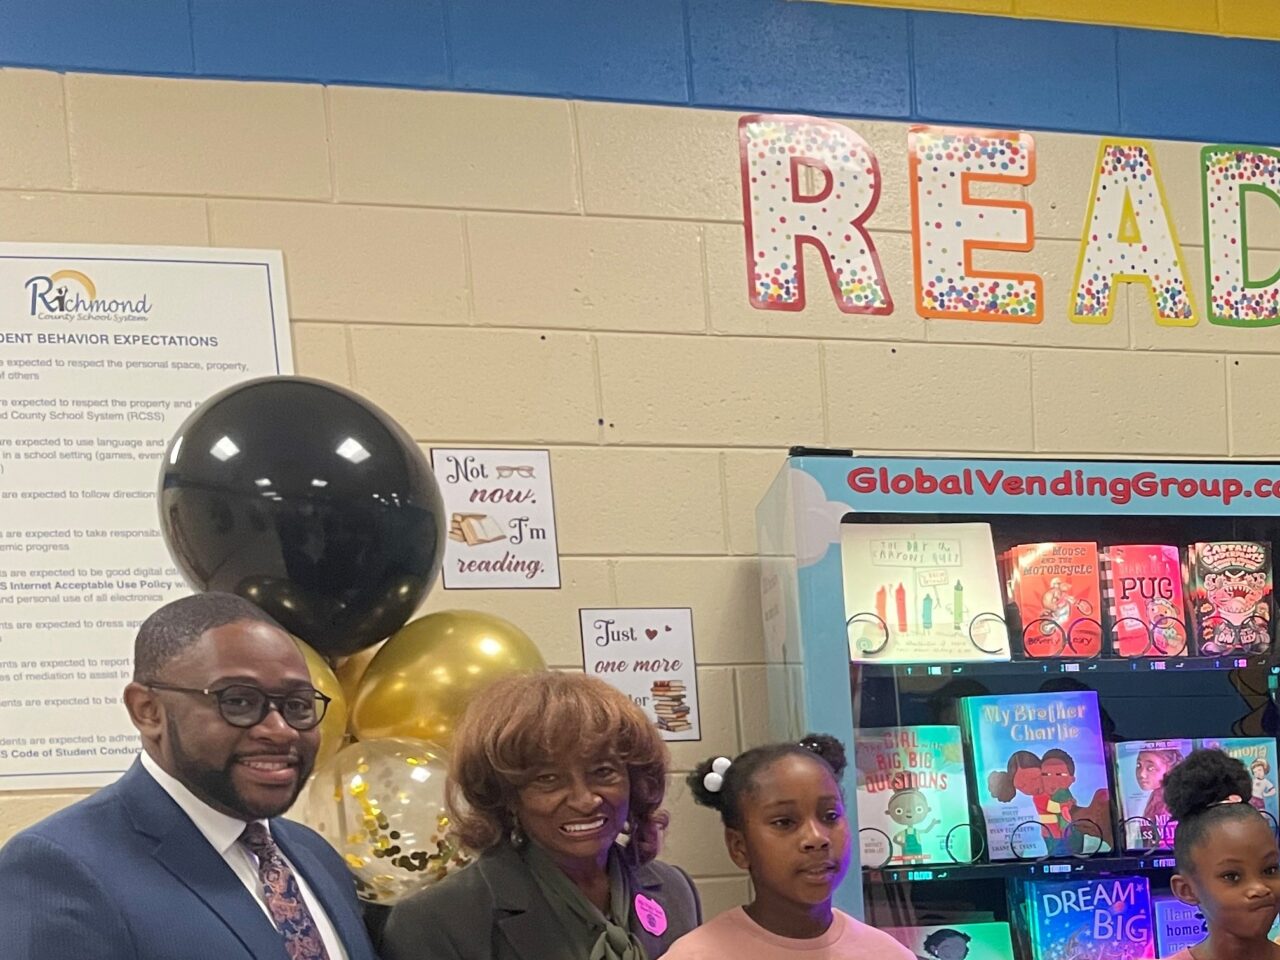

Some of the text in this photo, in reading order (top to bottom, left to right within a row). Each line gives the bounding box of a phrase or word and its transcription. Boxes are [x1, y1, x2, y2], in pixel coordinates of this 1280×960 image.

[25, 275, 152, 316] Richmond
[37, 312, 149, 322] County School System
[37, 333, 109, 345] BEHAVIOR
[114, 334, 219, 347] EXPECTATIONS
[7, 359, 249, 372] expected to respect the personal space, property,
[8, 372, 40, 380] others
[11, 399, 192, 410] expected to respect the property and
[11, 411, 165, 422] County School System (RCSS)
[15, 438, 61, 447] expected
[97, 438, 142, 448] language
[146, 439, 164, 447] and
[3, 451, 11, 459] in
[24, 451, 57, 459] school
[59, 451, 92, 461] setting
[95, 451, 136, 461] (games,
[447, 456, 488, 484] Not
[21, 490, 67, 499] expected
[69, 490, 79, 498] to
[82, 490, 110, 498] follow
[470, 487, 537, 504] now.
[25, 530, 71, 539] expected
[86, 529, 107, 537] take
[508, 517, 546, 544] I'm
[26, 543, 70, 552] progress
[1203, 544, 1258, 557] CAPTAIN
[457, 552, 545, 579] reading.
[30, 569, 75, 578] expected
[91, 568, 103, 576] be
[106, 568, 131, 578] good
[134, 567, 162, 577] digital
[10, 580, 172, 591] Internet Acceptable Use Policy
[1119, 577, 1173, 600] PUG
[17, 594, 60, 604] personal
[84, 594, 93, 602] of
[96, 593, 108, 602] all
[111, 593, 164, 602] electronics
[16, 619, 124, 630] are expected to dress
[593, 619, 637, 647] Just
[40, 659, 85, 669] expected
[100, 658, 130, 667] report
[595, 658, 683, 673] one more
[26, 671, 74, 681] mediation
[77, 671, 87, 679] to
[90, 670, 118, 679] assist
[120, 670, 129, 678] in
[44, 697, 90, 707] expected
[92, 697, 102, 705] to
[105, 696, 117, 704] be
[982, 701, 1087, 726] My Brother
[1010, 724, 1080, 742] Charlie
[49, 736, 94, 745] expected
[97, 735, 106, 743] to
[884, 731, 919, 749] GIRL
[11, 748, 97, 758] Code of Student
[909, 751, 932, 769] BIG
[865, 772, 948, 794] QUESTIONS
[1042, 880, 1136, 919] DREAM
[1093, 909, 1148, 942] BIG
[1167, 925, 1199, 937] home
